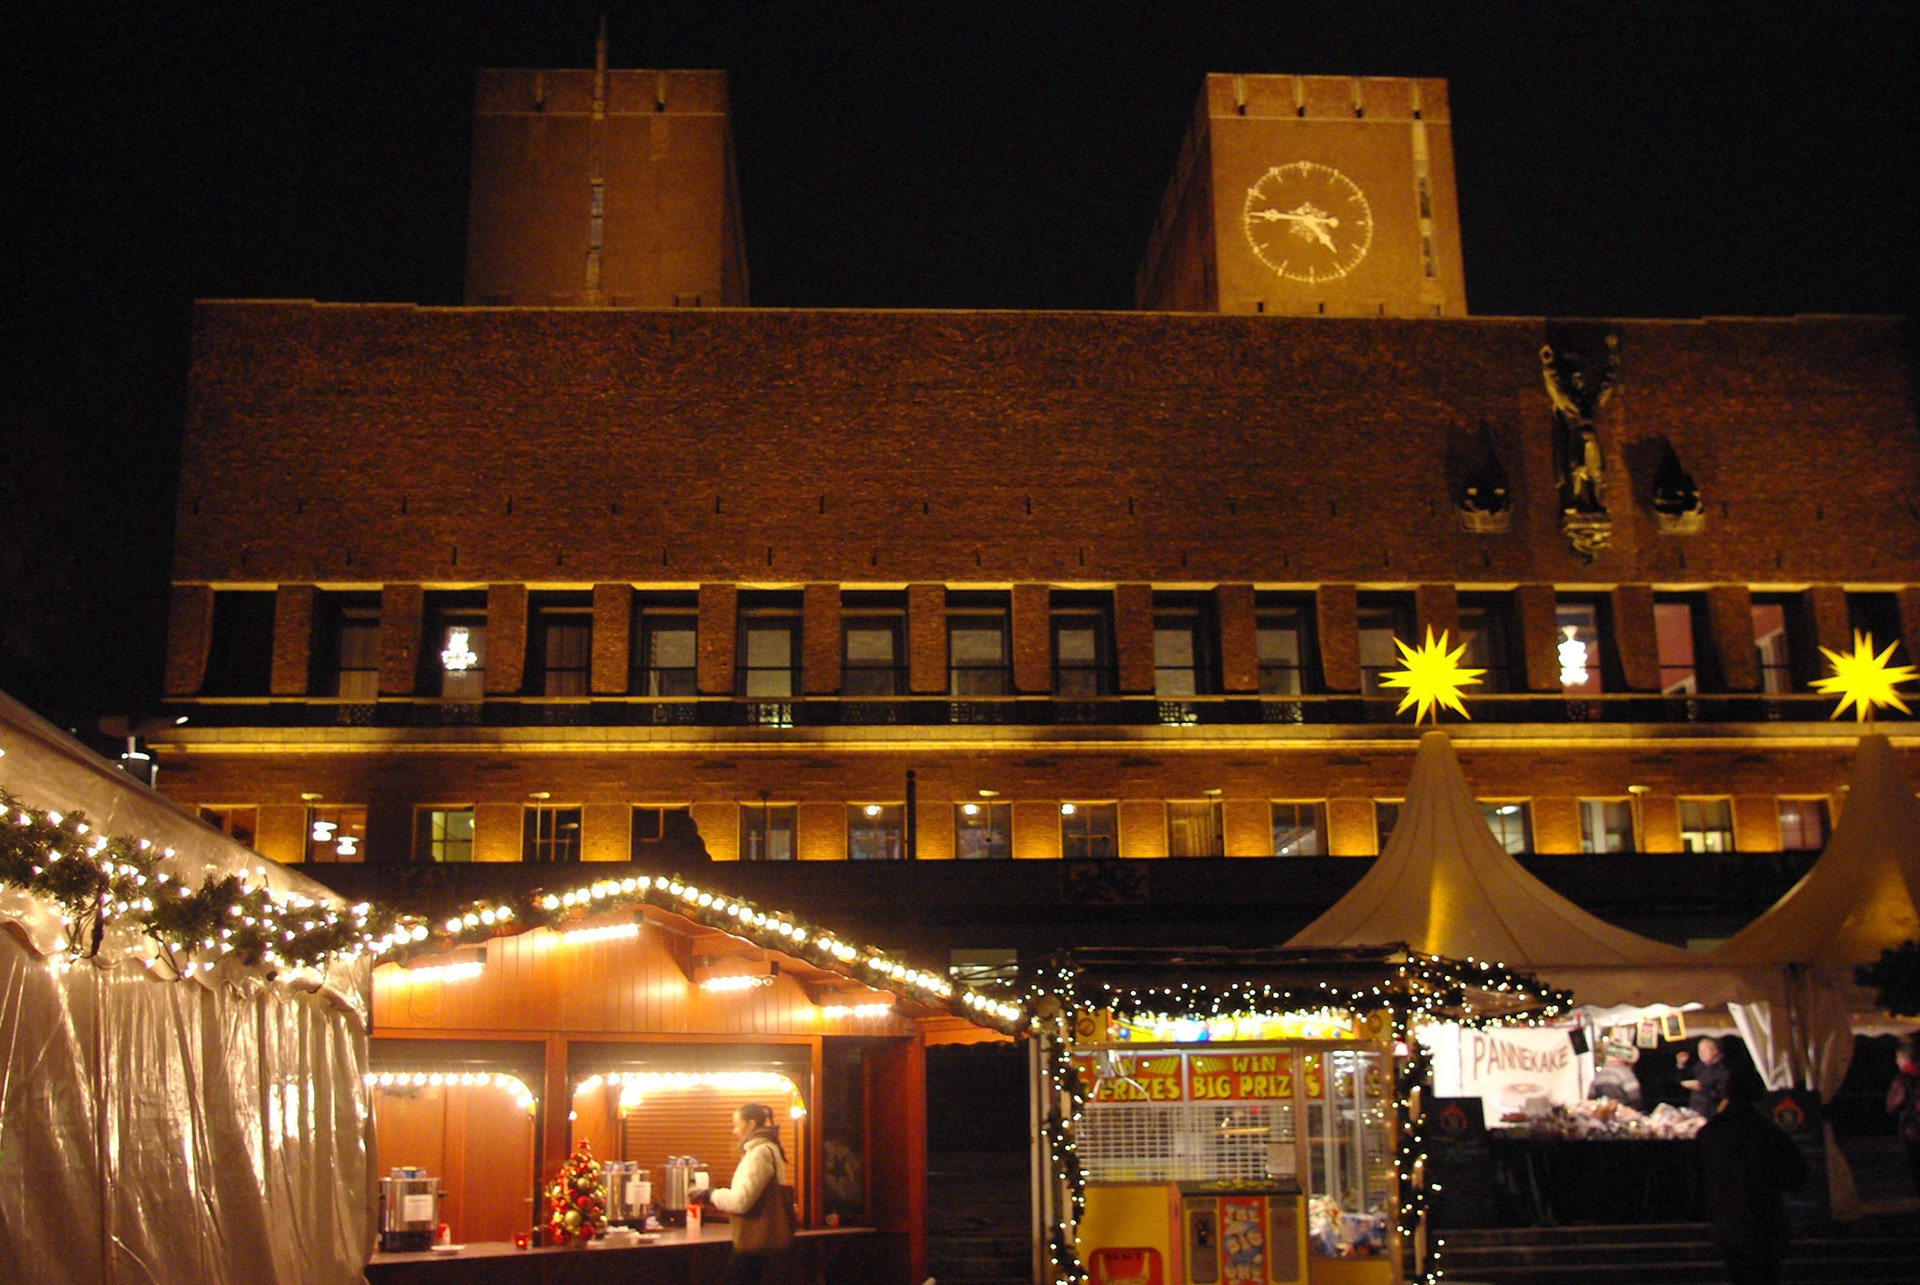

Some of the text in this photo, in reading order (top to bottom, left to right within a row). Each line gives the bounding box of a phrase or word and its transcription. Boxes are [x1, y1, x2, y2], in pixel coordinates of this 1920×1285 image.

[1231, 1056, 1277, 1073] WIN
[1473, 1035, 1569, 1080] PANNEKAKE
[1192, 1074, 1321, 1099] BIG PRIZS
